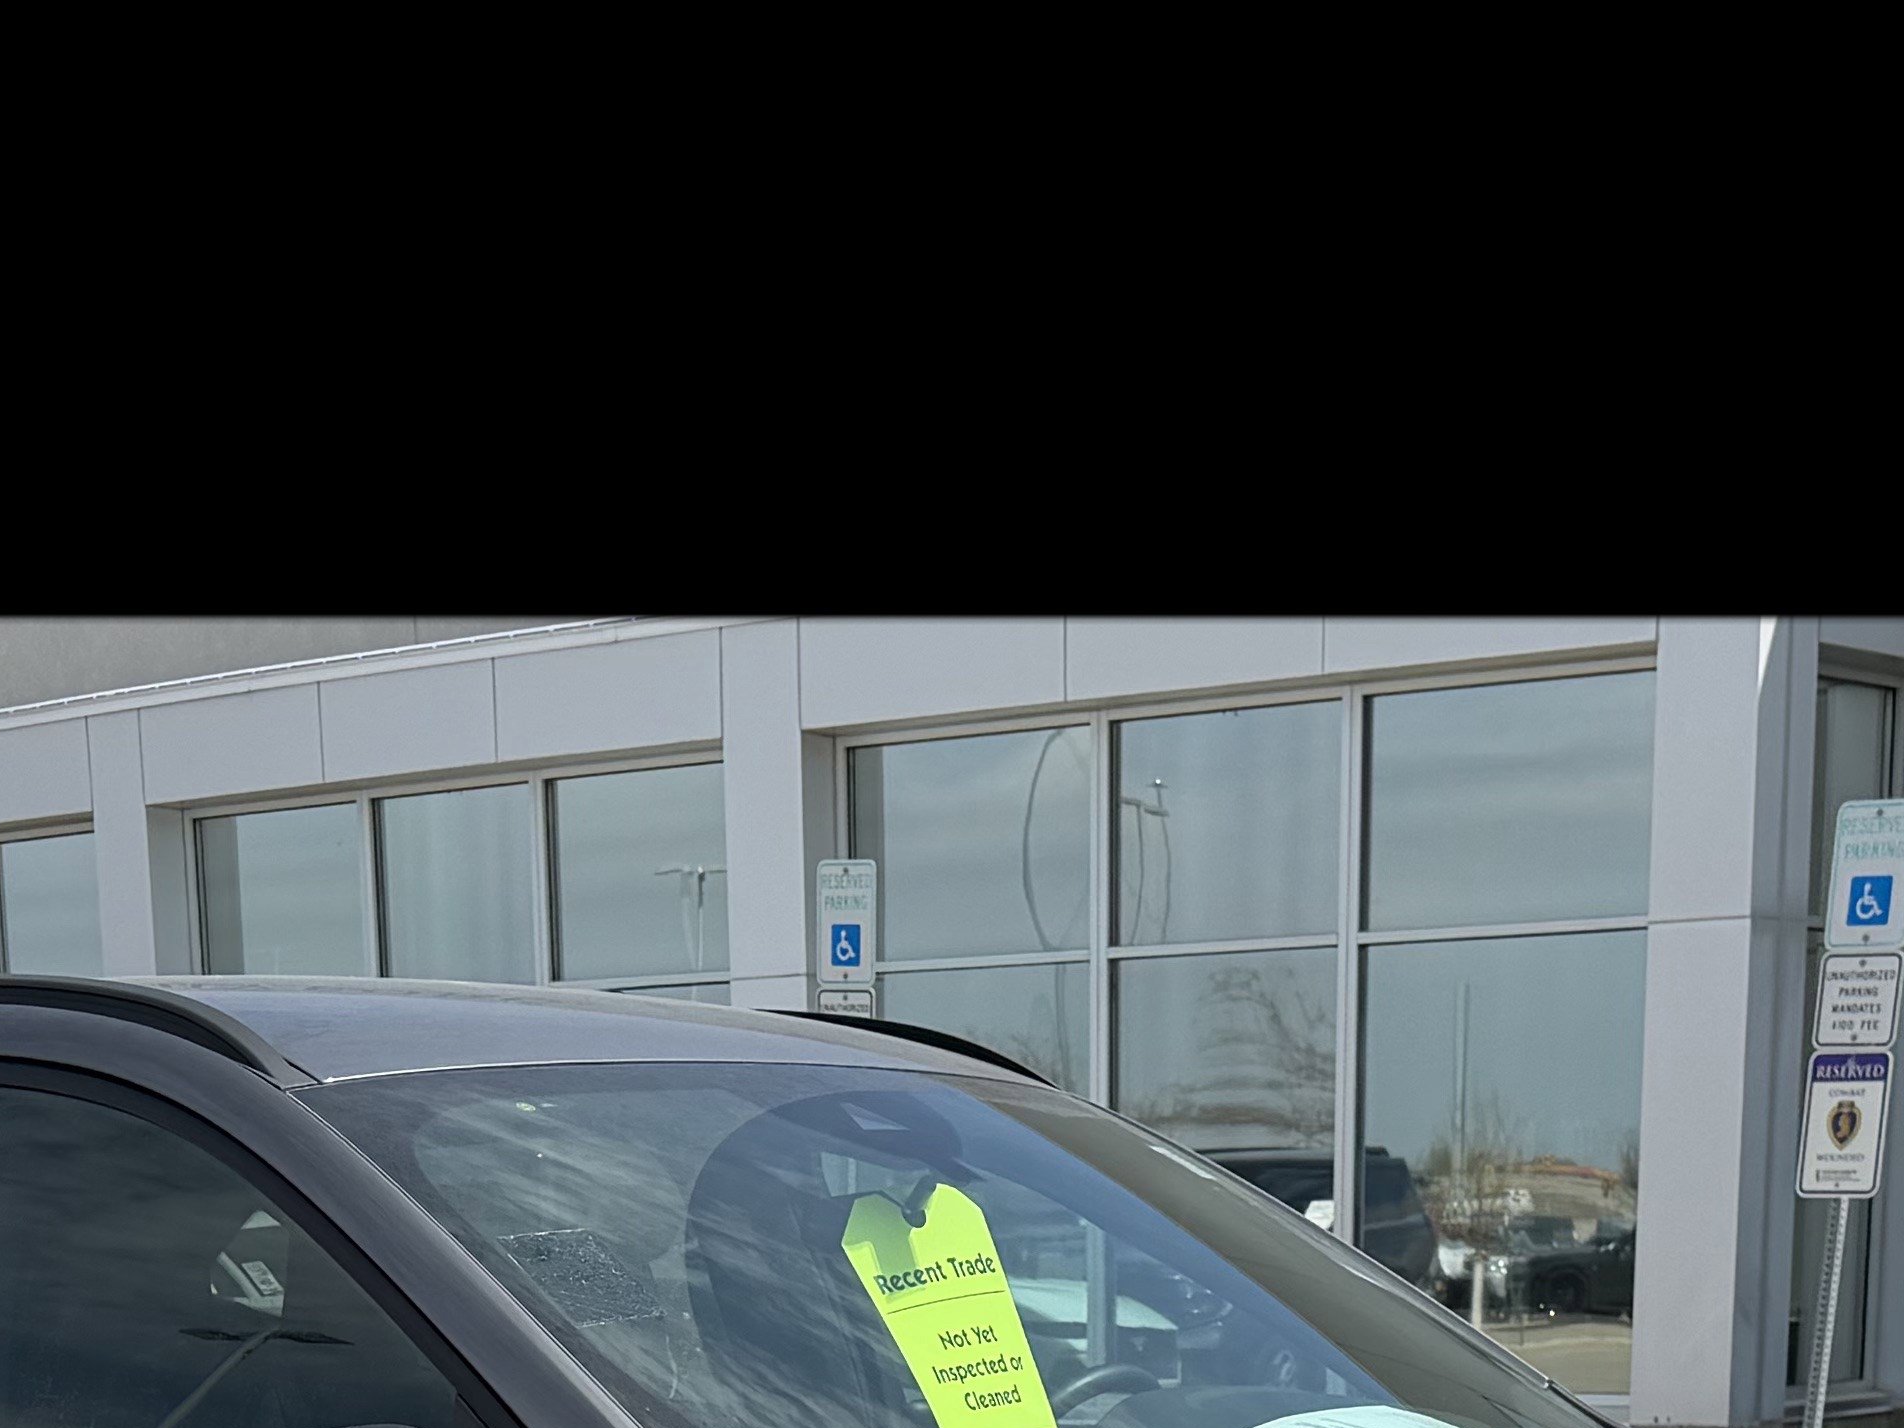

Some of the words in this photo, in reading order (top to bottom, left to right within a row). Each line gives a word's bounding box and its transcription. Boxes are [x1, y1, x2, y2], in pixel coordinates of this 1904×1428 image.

[821, 874, 872, 889] RESERVED
[825, 895, 867, 910] PARKING
[1839, 986, 1879, 996] PARKING
[1816, 1063, 1885, 1078] RESERVED
[873, 1262, 947, 1295] Recent
[947, 1253, 996, 1282] Trade
[938, 1328, 972, 1350] Not
[971, 1325, 997, 1346] Yet
[932, 1354, 1007, 1384] Inspected
[1010, 1355, 1024, 1371] or
[964, 1384, 1022, 1411] Cleaned
